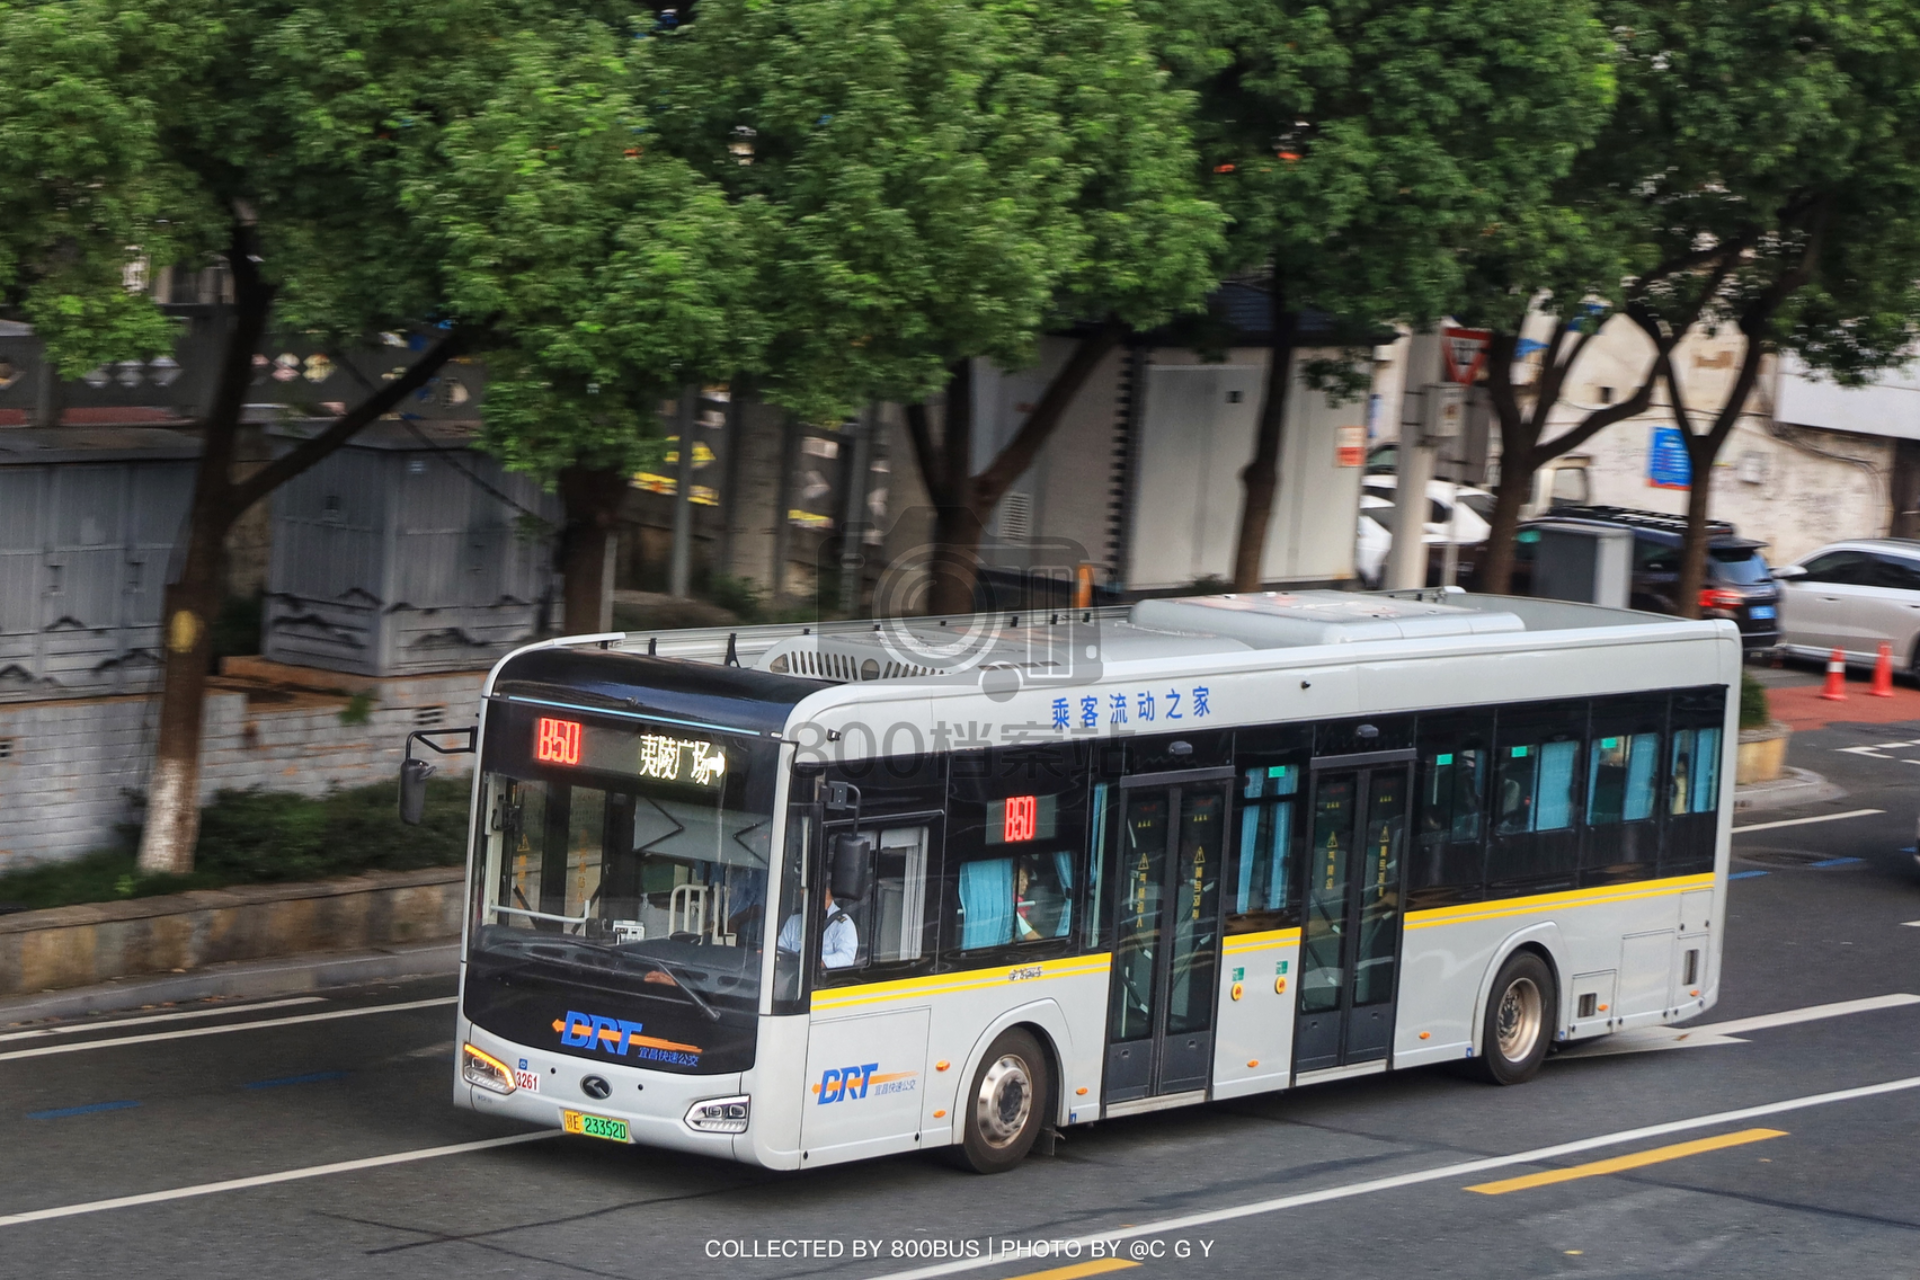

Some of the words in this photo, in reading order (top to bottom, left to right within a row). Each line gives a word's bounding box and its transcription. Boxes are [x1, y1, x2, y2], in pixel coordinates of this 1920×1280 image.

[1052, 685, 1211, 730] 乘客流动之家
[538, 717, 582, 766] B50
[639, 733, 711, 786] 夷陵广场
[1004, 795, 1036, 842] B50
[561, 1010, 643, 1056] BRT
[638, 1047, 700, 1067] 宜昌快速公交
[516, 1071, 538, 1091] 3261
[817, 1062, 879, 1105] BRT
